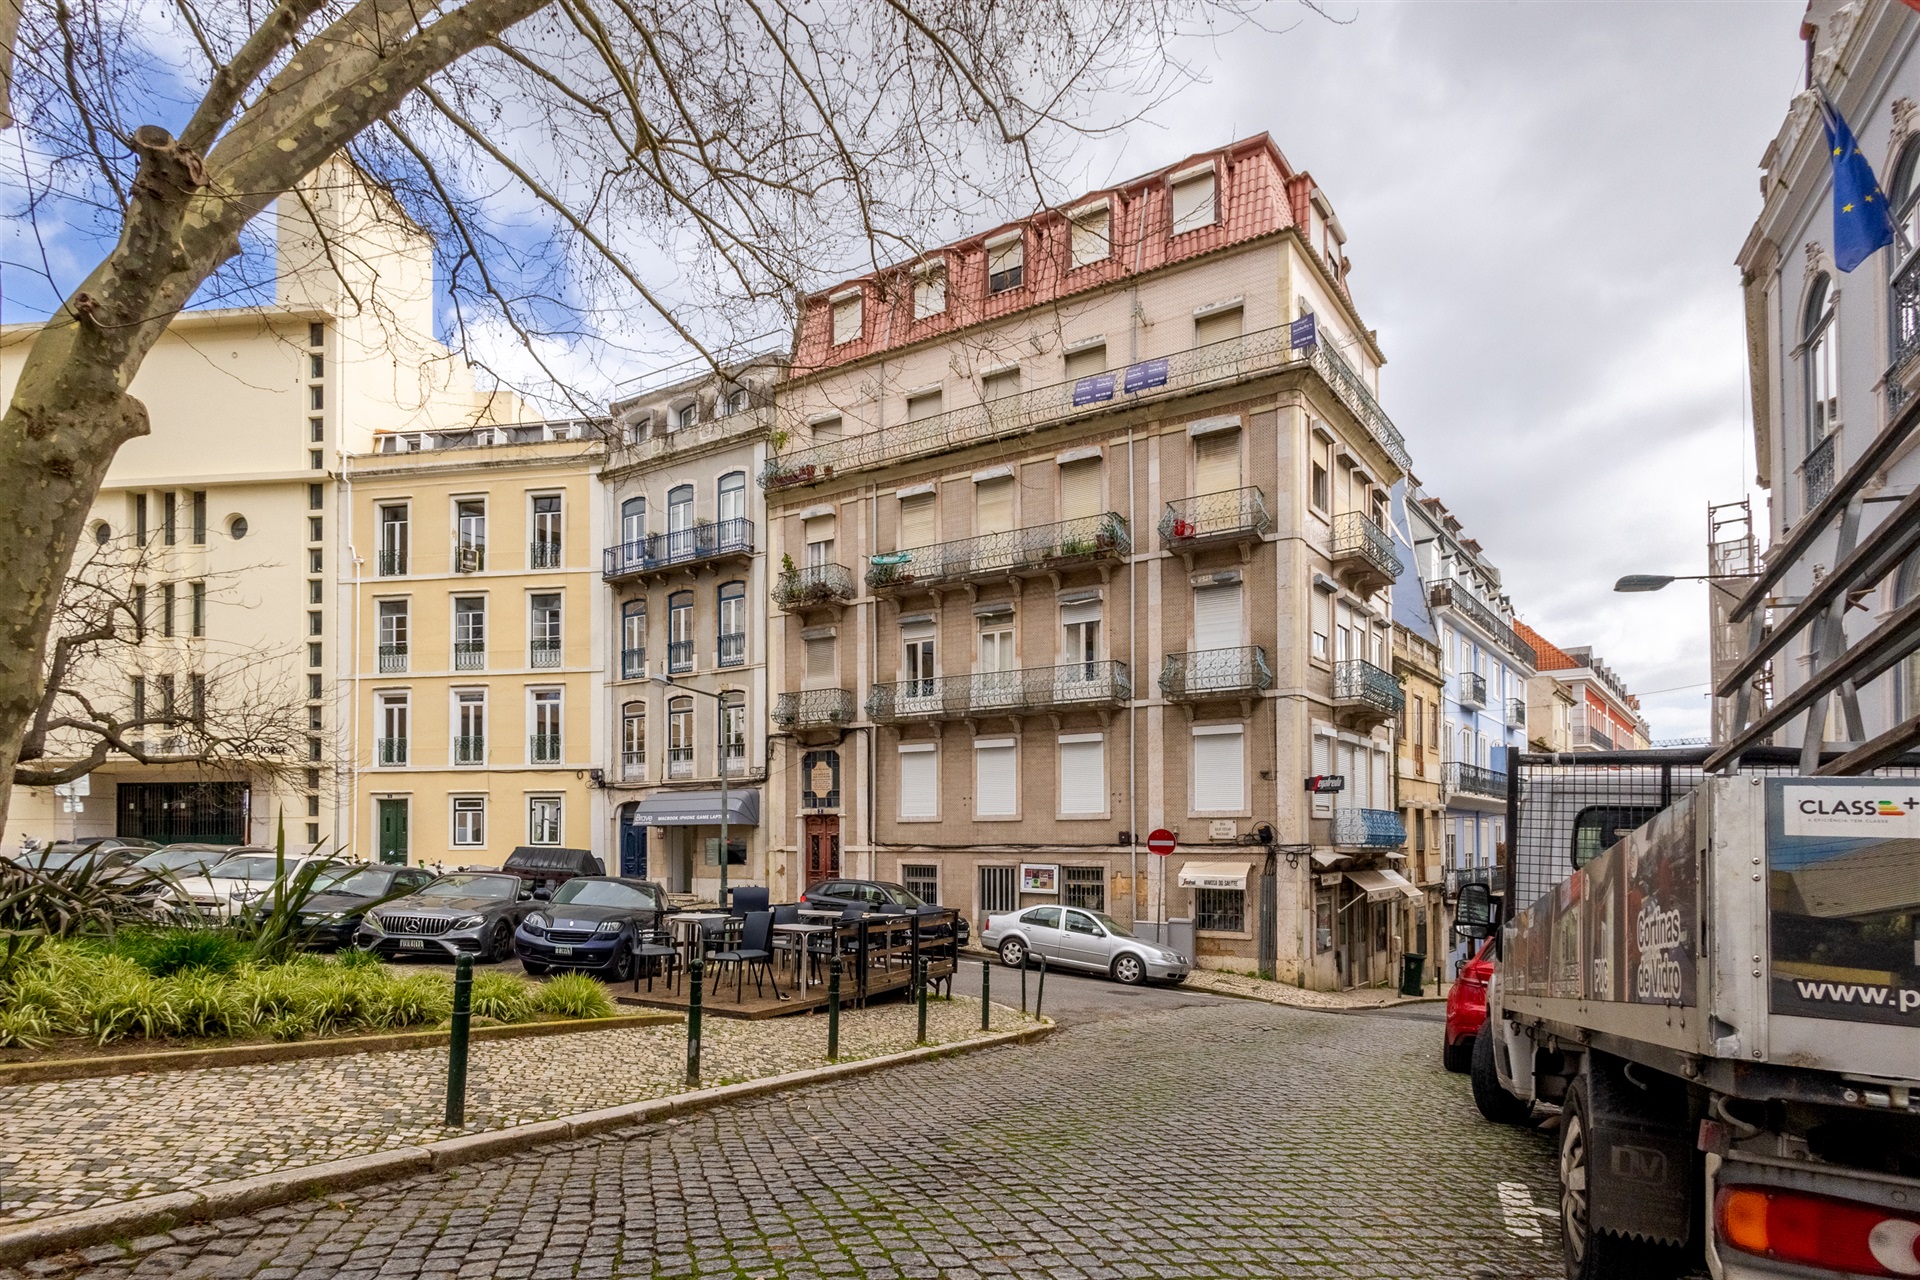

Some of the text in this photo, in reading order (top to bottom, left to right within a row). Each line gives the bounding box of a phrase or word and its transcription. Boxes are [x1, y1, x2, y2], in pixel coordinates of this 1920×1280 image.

[1637, 907, 1680, 949] Cortinas
[1638, 954, 1682, 999] de Vidro
